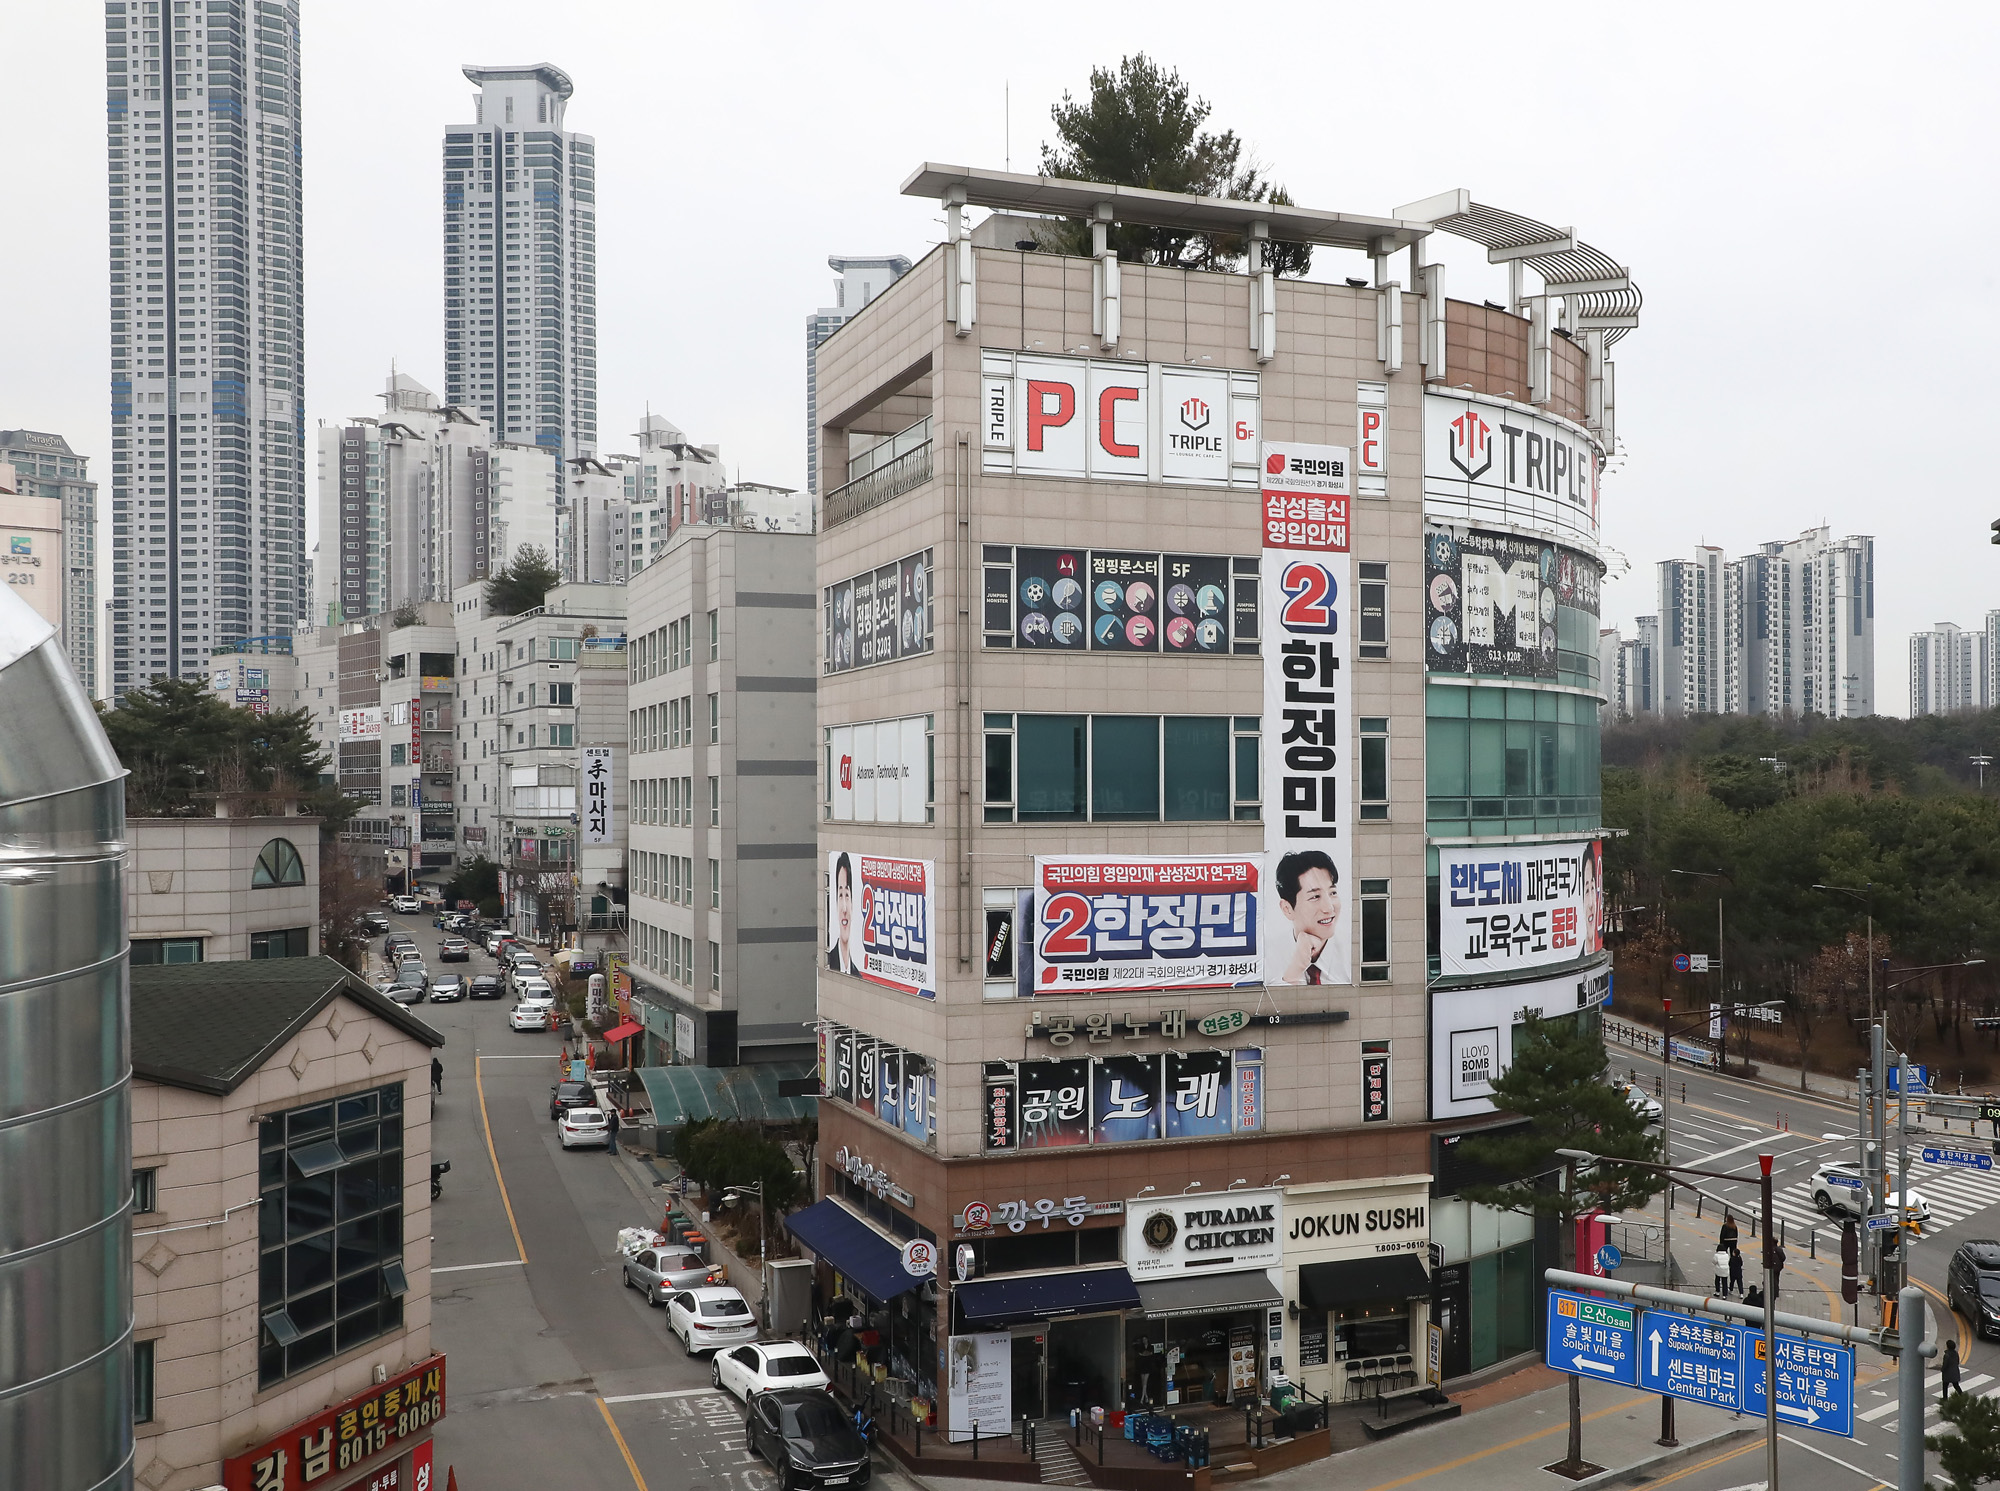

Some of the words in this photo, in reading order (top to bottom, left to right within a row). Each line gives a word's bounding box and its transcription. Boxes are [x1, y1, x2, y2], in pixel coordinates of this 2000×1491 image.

[990, 386, 1004, 440] TRIPLE
[1027, 379, 1140, 458] PC
[26, 433, 62, 446] Paragon
[1170, 434, 1222, 452] TRIPLE
[1236, 421, 1254, 440] 6F
[1363, 412, 1379, 467] PC
[1290, 458, 1344, 477] 국민의힘
[1500, 424, 1586, 508] TRIPLE
[1316, 480, 1327, 488] 경기
[1266, 496, 1346, 522] 삼성출신
[1266, 521, 1346, 546] 영입인재
[8, 572, 35, 585] 231
[1093, 558, 1158, 576] 점핑몬스터
[1172, 564, 1190, 578] 5F
[1281, 561, 1338, 635] 2
[1281, 639, 1340, 838] 한정민
[1048, 866, 1100, 883] 국민의힘
[1210, 864, 1247, 881] 연구원
[1450, 861, 1522, 907] 반도체
[1526, 856, 1581, 901] 패권국가
[862, 884, 876, 946] 2
[874, 887, 925, 954] 한정민
[1041, 892, 1092, 956] 2
[1094, 893, 1247, 952] 한정민
[990, 940, 1002, 962] ZERO
[997, 922, 1008, 941] GYM
[1465, 911, 1547, 960] 교육수도
[1552, 906, 1577, 949] 동탄
[1062, 968, 1108, 981] 국민의힘
[1113, 967, 1144, 980] 제22대
[1147, 965, 1205, 978] 국회의원선거
[1207, 964, 1227, 976] 경기
[1229, 962, 1257, 975] 화성시
[591, 988, 602, 1014] 마사지
[1048, 1009, 1186, 1046] 공원노래
[1204, 1010, 1243, 1036] 연습장
[1269, 1016, 1280, 1024] 03
[1461, 1045, 1489, 1058] LLOYD
[1462, 1058, 1489, 1071] BOMB
[883, 1062, 923, 1124] 노래
[1022, 1086, 1085, 1122] 공원
[1102, 1071, 1220, 1123] 노래
[1243, 1070, 1255, 1127] 대형룸완비
[1370, 1064, 1381, 1116] 단체환영
[993, 1087, 1006, 1146] 최신음향기기
[1939, 1150, 1976, 1162] 동탄지성로
[998, 1196, 1092, 1233] 깡우동
[1185, 1205, 1274, 1228] PURADAK
[1290, 1213, 1360, 1239] JOKUN
[1366, 1207, 1424, 1231] SUSHI
[1185, 1227, 1274, 1250] CHICKEN
[1375, 1241, 1424, 1252] T.8003-0610
[1558, 1300, 1576, 1315] 317
[1582, 1308, 1606, 1323] 오산
[1606, 1315, 1630, 1328] Osan
[1565, 1323, 1623, 1349] 솔빛마을
[1669, 1322, 1736, 1348] 숲속초등학교
[1562, 1337, 1591, 1352] Solbit
[1592, 1343, 1625, 1361] Village
[1668, 1338, 1693, 1353] Supsok
[1695, 1342, 1721, 1360] Primary
[1723, 1349, 1736, 1360] Sch
[1776, 1342, 1837, 1368] 서동탄역
[1668, 1359, 1736, 1389] 센트럴파크
[1776, 1358, 1823, 1378] W.Dongtan
[1824, 1368, 1839, 1380] Stn
[340, 1367, 441, 1441] 공인중개사
[1668, 1379, 1706, 1398] Central
[1710, 1389, 1736, 1404] Park
[1754, 1384, 1796, 1402] Susok
[1800, 1393, 1838, 1412] Village
[339, 1395, 441, 1470] 8015-8086
